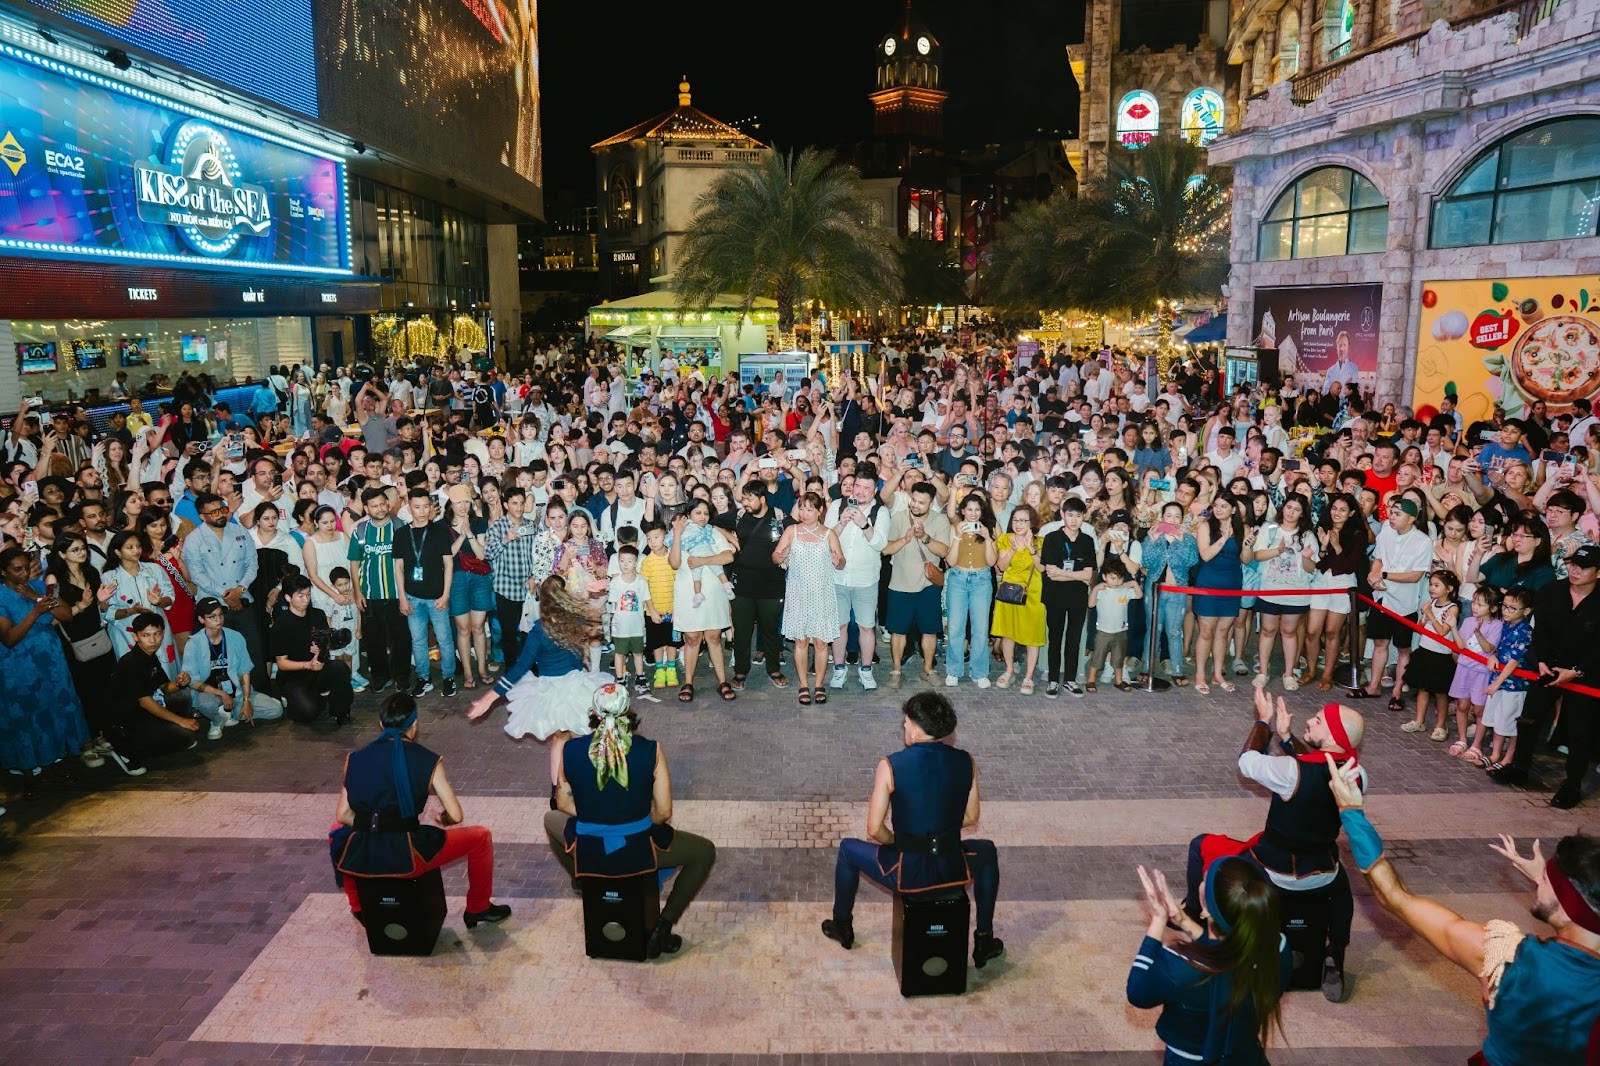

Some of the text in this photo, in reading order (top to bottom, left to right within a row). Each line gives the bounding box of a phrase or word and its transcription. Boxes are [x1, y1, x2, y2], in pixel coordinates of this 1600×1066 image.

[45, 150, 85, 172] ECA2
[138, 168, 270, 222] KISS of the SEA
[128, 288, 157, 300] TICKETS
[1288, 308, 1350, 328] Artisan Boulangerie
[1301, 322, 1334, 340] from Paris
[1480, 323, 1498, 334] BEST
[364, 543, 393, 554] Origina
